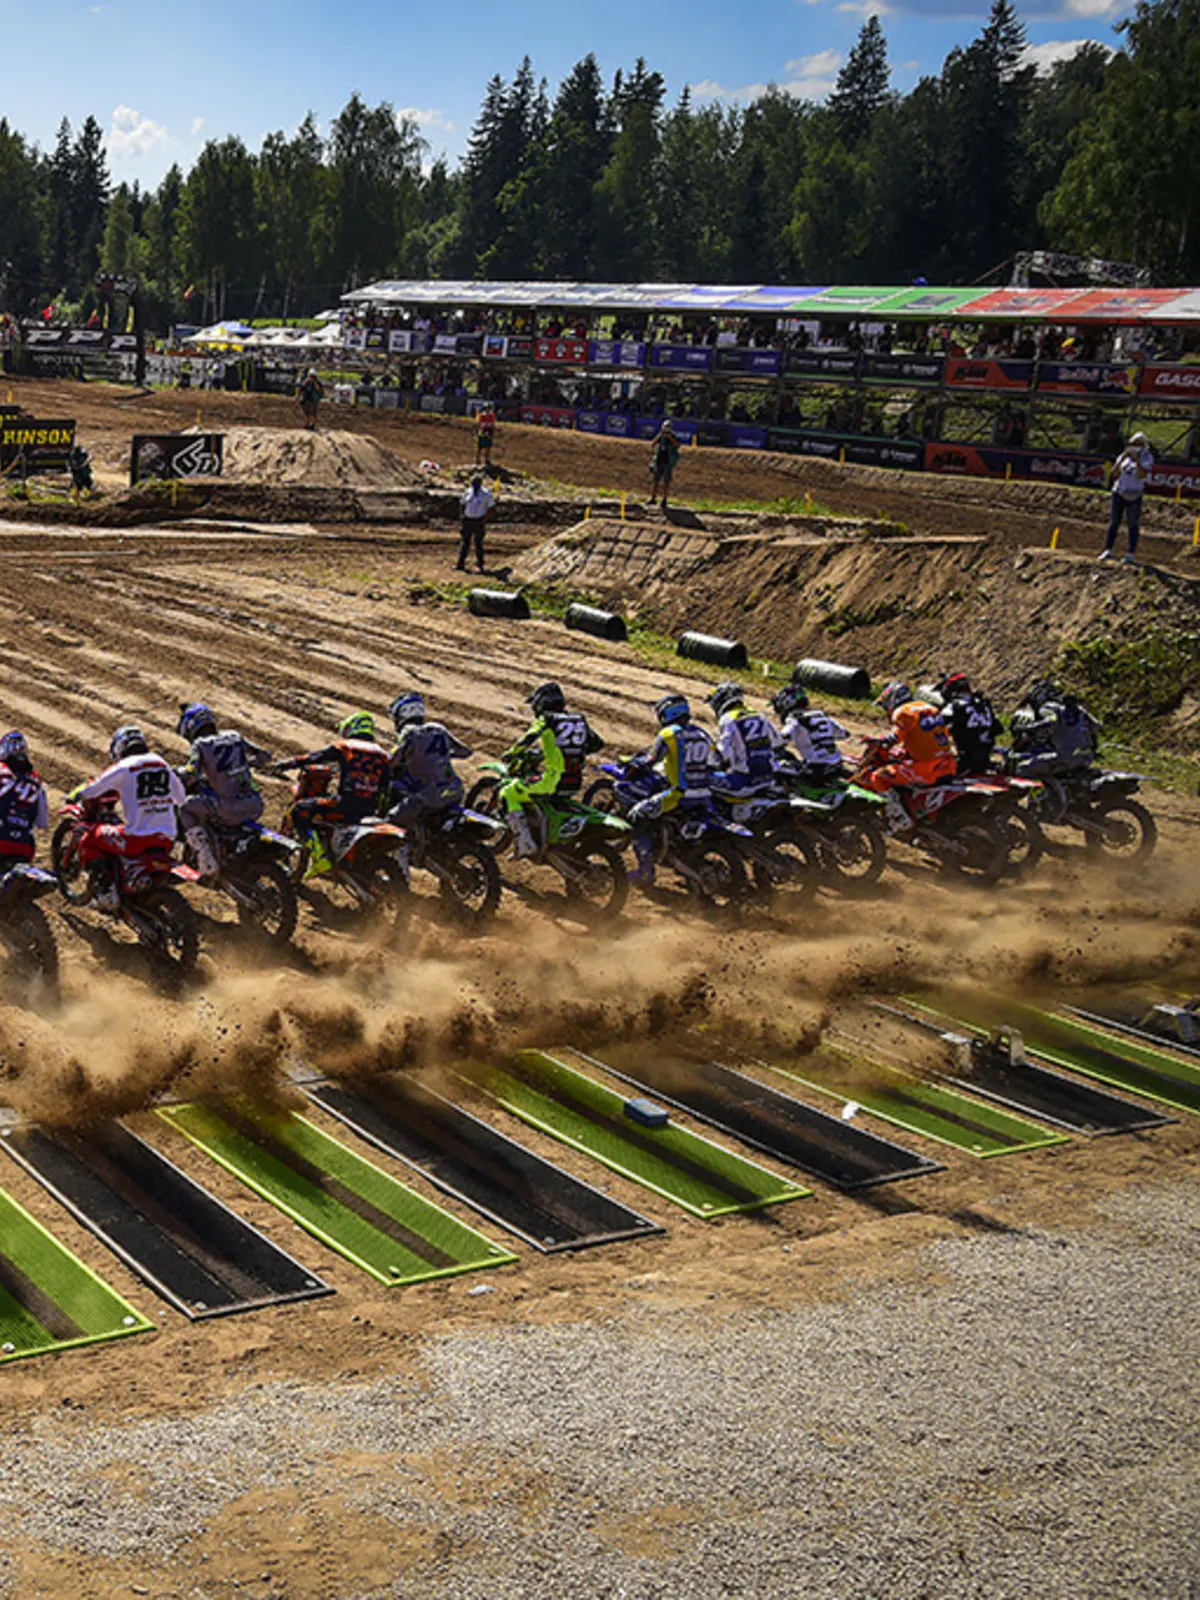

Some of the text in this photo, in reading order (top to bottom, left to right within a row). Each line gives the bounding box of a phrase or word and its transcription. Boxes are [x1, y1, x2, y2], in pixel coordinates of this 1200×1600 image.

[3, 428, 74, 445] HINSON
[556, 721, 587, 746] 25
[684, 740, 709, 763] 10
